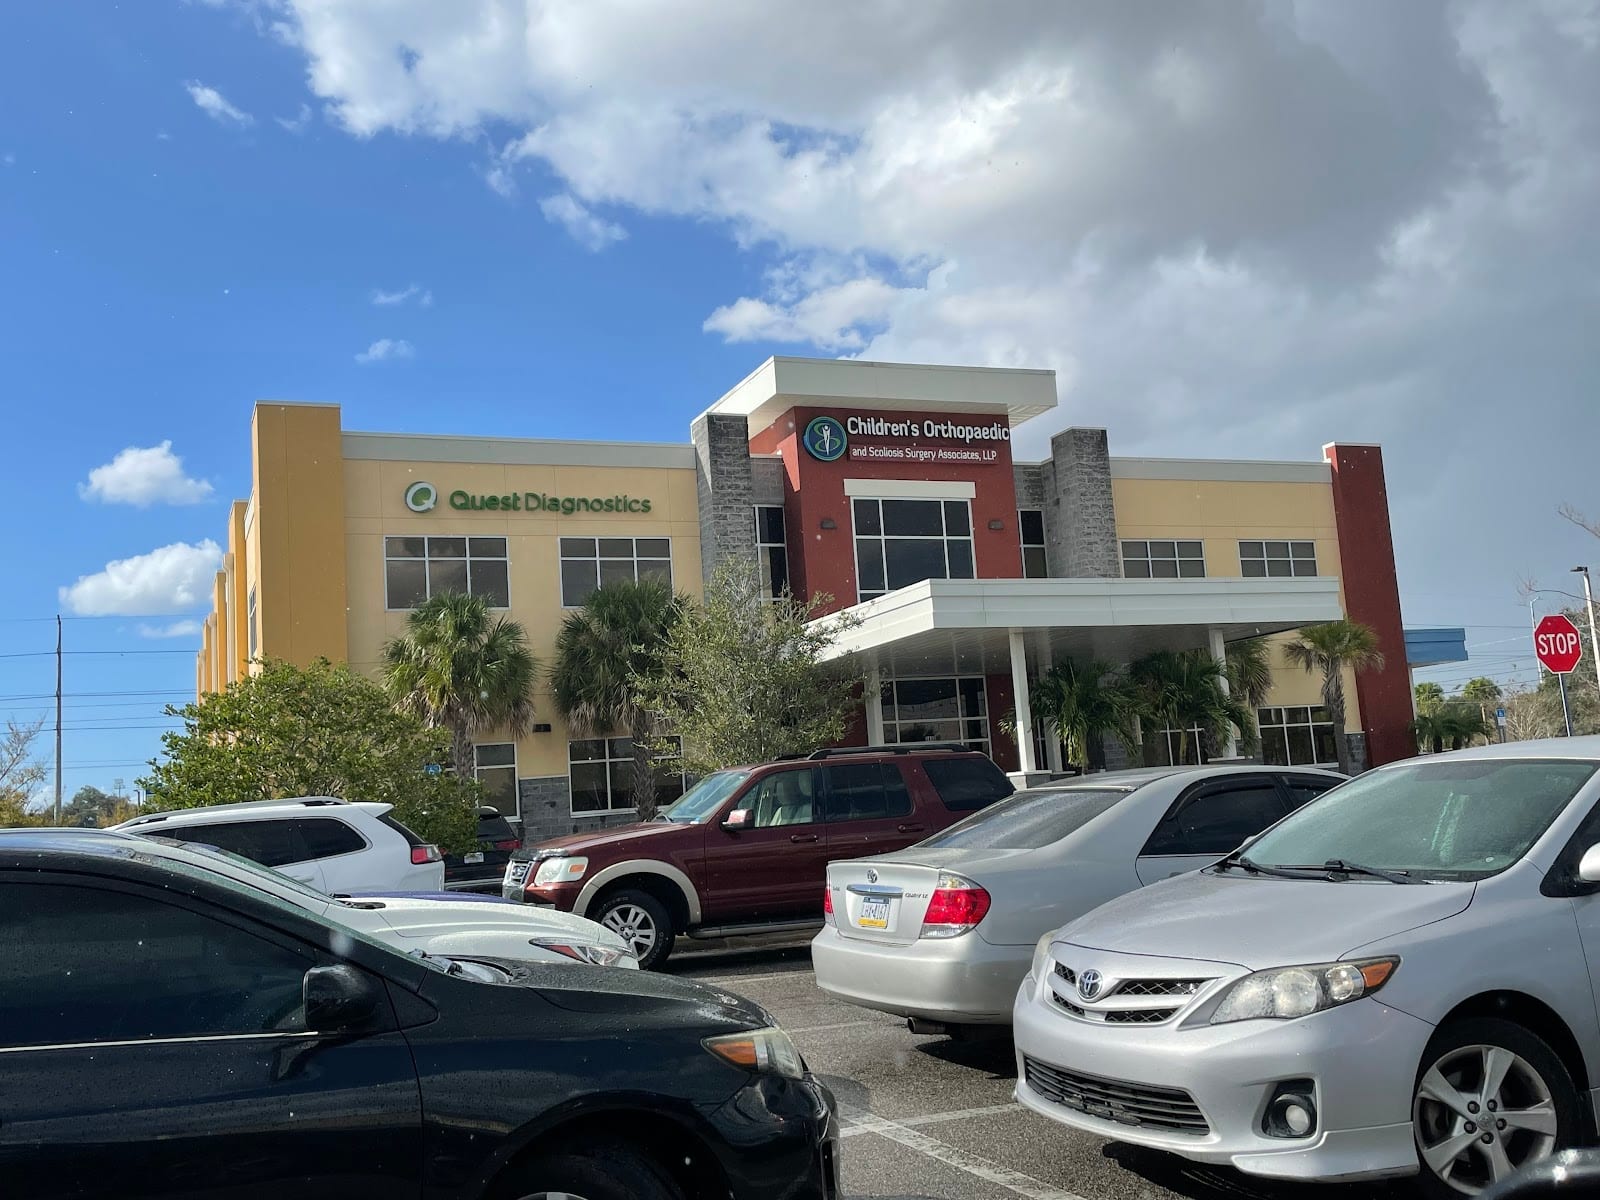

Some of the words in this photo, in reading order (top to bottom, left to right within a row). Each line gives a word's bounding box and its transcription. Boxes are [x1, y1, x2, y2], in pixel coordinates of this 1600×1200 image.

[847, 416, 920, 437] Children's
[923, 420, 1010, 444] Orthopaedic
[852, 446, 867, 457] and
[868, 446, 904, 458] Scoliosis
[906, 448, 936, 462] Surgery
[937, 450, 982, 462] Associates,
[982, 451, 997, 461] LLP
[449, 490, 522, 511] Quest
[525, 492, 653, 515] Diagnostics
[1537, 633, 1577, 655] STOP
